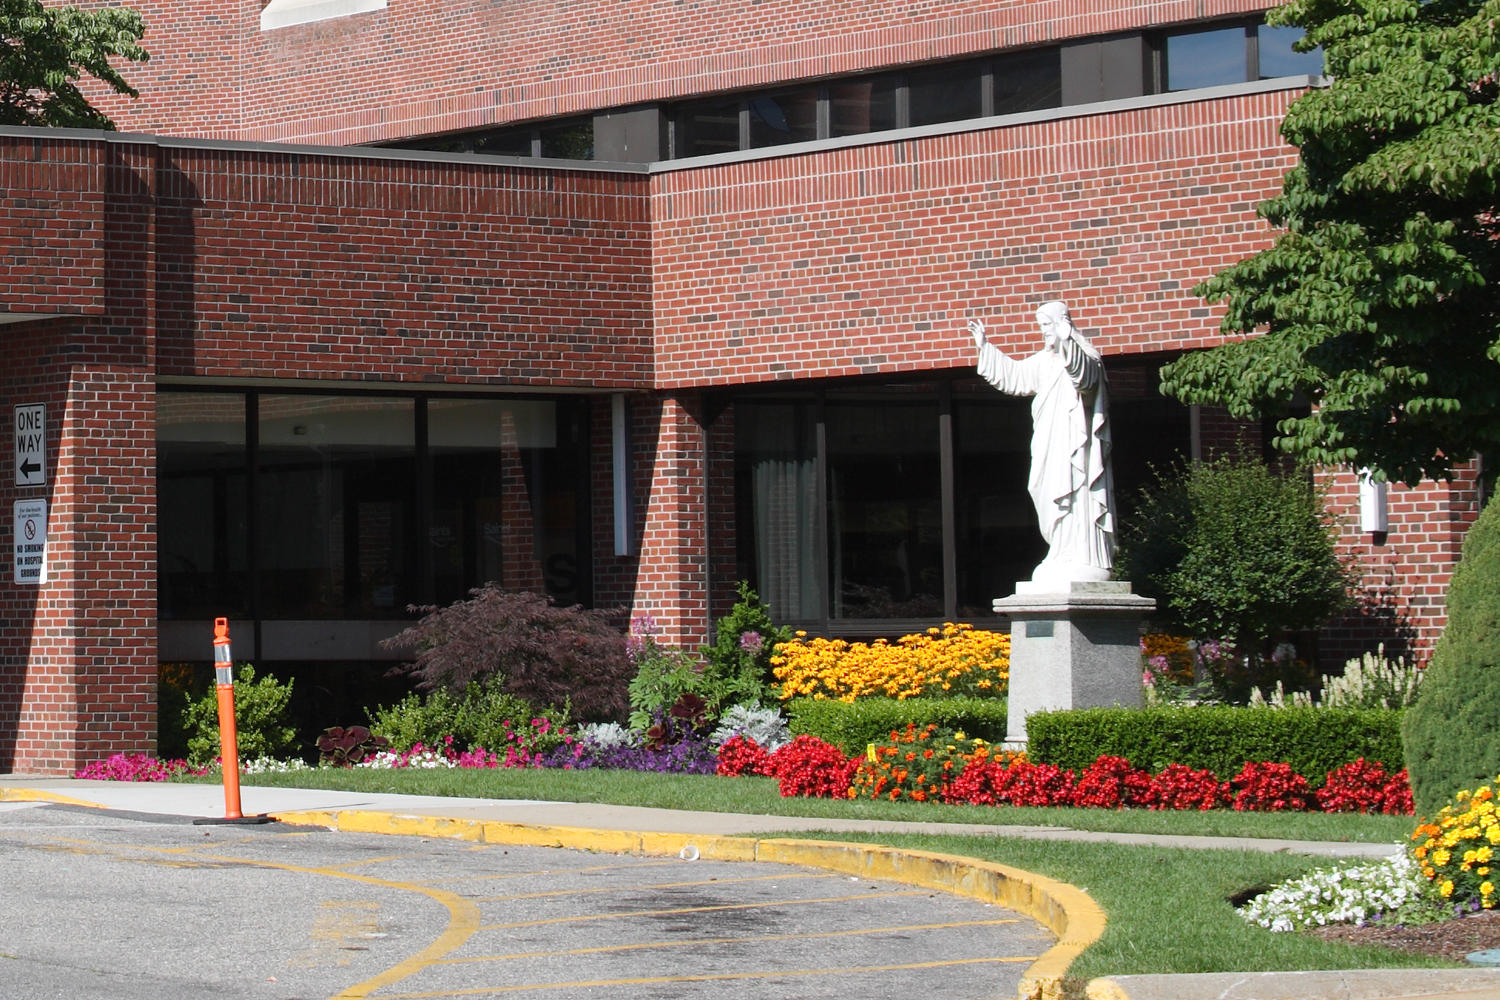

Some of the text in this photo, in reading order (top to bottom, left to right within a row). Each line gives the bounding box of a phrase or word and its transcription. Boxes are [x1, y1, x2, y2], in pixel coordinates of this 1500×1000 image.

[18, 411, 41, 431] ONE
[17, 433, 42, 453] WAY
[17, 543, 44, 553] NO SMOKING
[17, 556, 23, 565] ON
